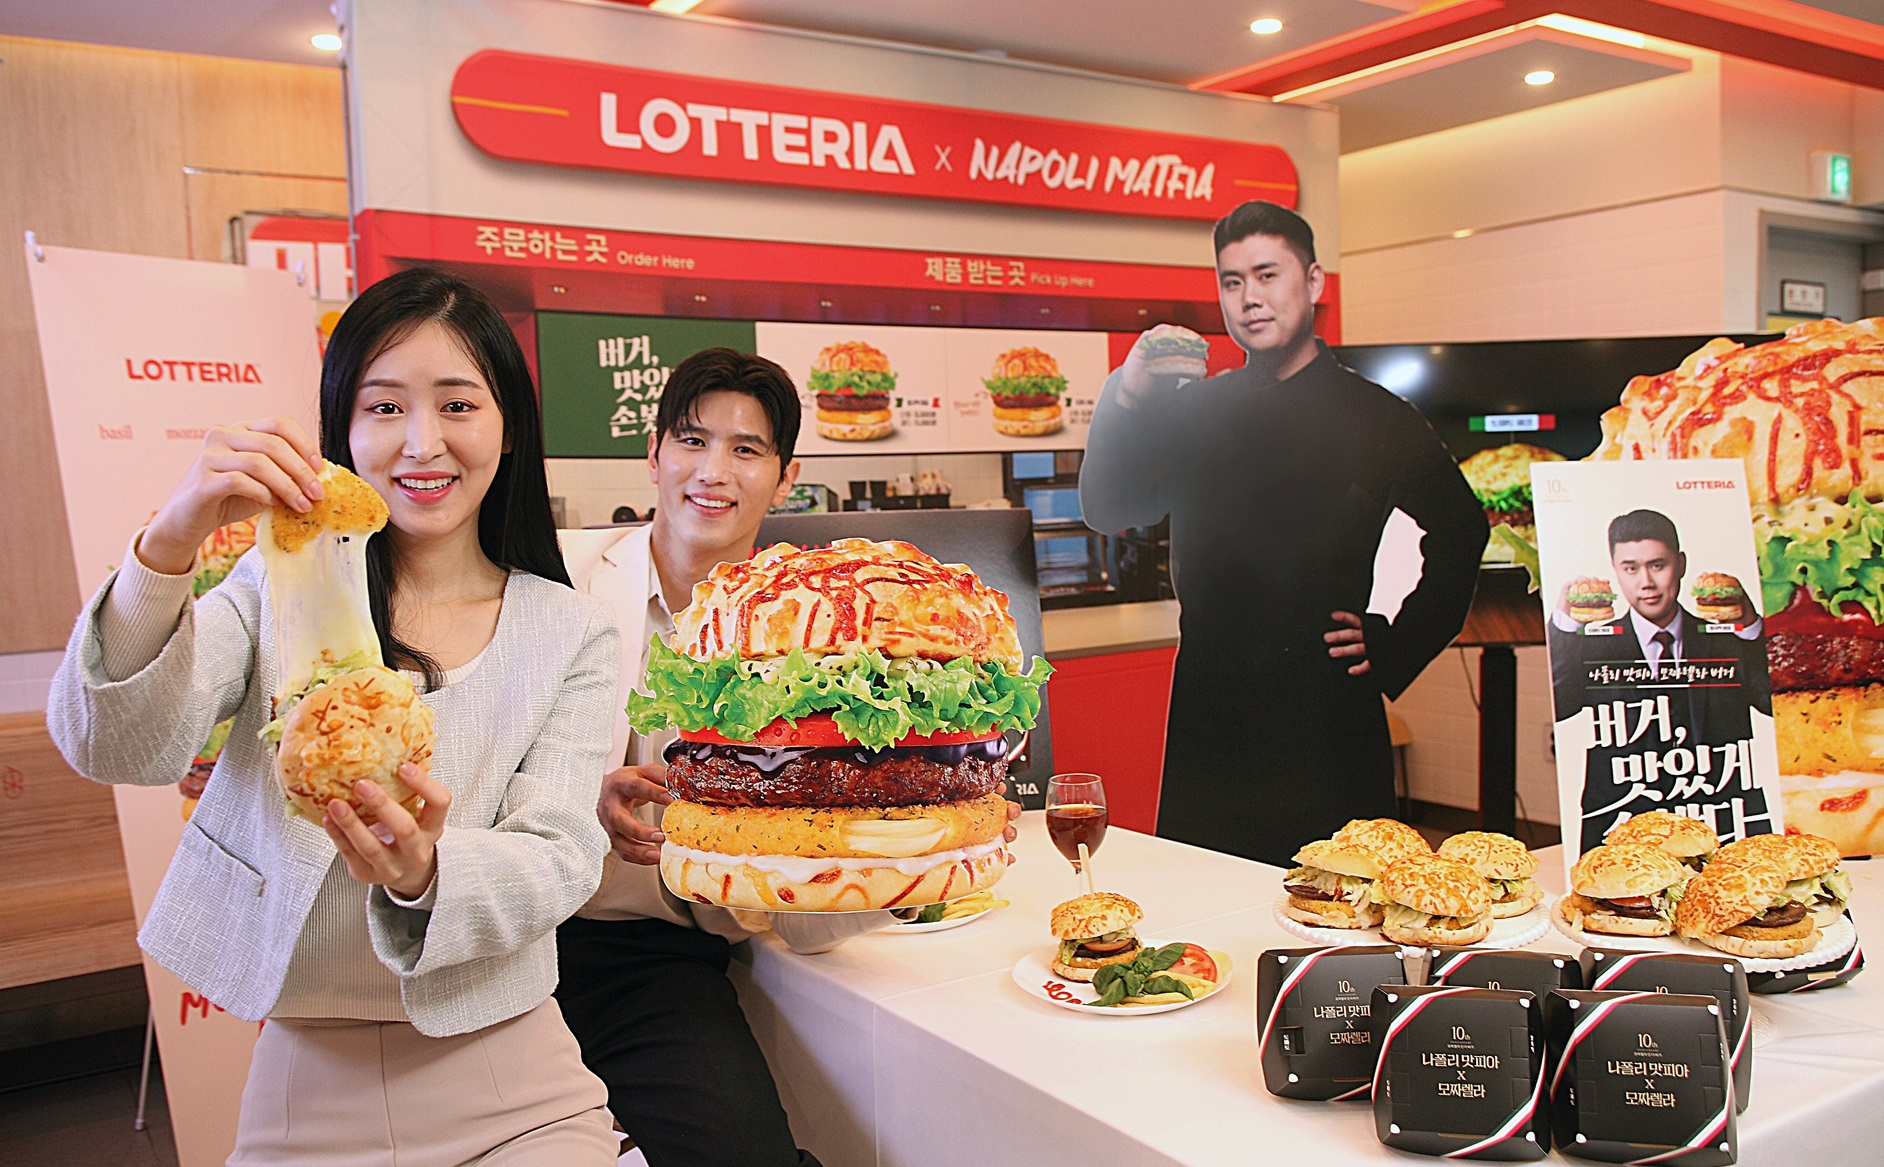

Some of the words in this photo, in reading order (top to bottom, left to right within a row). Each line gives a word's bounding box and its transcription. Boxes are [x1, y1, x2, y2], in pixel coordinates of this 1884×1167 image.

[600, 92, 916, 175] LOTTERIA
[969, 138, 1099, 191] NAPOLI
[1104, 154, 1215, 201] MATFIA
[476, 226, 579, 261] 주문하는
[584, 234, 609, 264] 곳
[616, 251, 659, 267] Order
[662, 255, 695, 270] Here
[925, 257, 962, 284] 제품
[967, 259, 1004, 286] 받는
[1008, 261, 1026, 286] 곳
[1031, 272, 1052, 285] Pick
[1071, 276, 1094, 288] Here
[598, 334, 659, 368] 버거,
[126, 359, 262, 384] LOTTERIA
[613, 366, 675, 403] 맛있
[1676, 480, 1735, 490] LOTTERIA
[1710, 665, 1735, 681] 버거
[1581, 694, 1687, 750] 버거,
[1584, 738, 1762, 817] 맛있게
[1313, 1005, 1348, 1019] 나폴리
[1348, 1004, 1371, 1018] 맛피
[1451, 1026, 1471, 1040] 10th
[1638, 1033, 1658, 1048] 10th
[1422, 1052, 1459, 1068] 나폴리
[1461, 1054, 1500, 1069] 맛피아
[1607, 1060, 1648, 1076] 나폴리
[1648, 1062, 1690, 1078] 맛피아
[1438, 1083, 1487, 1098] 모짜렐라
[1625, 1091, 1676, 1108] 모짜렐라
